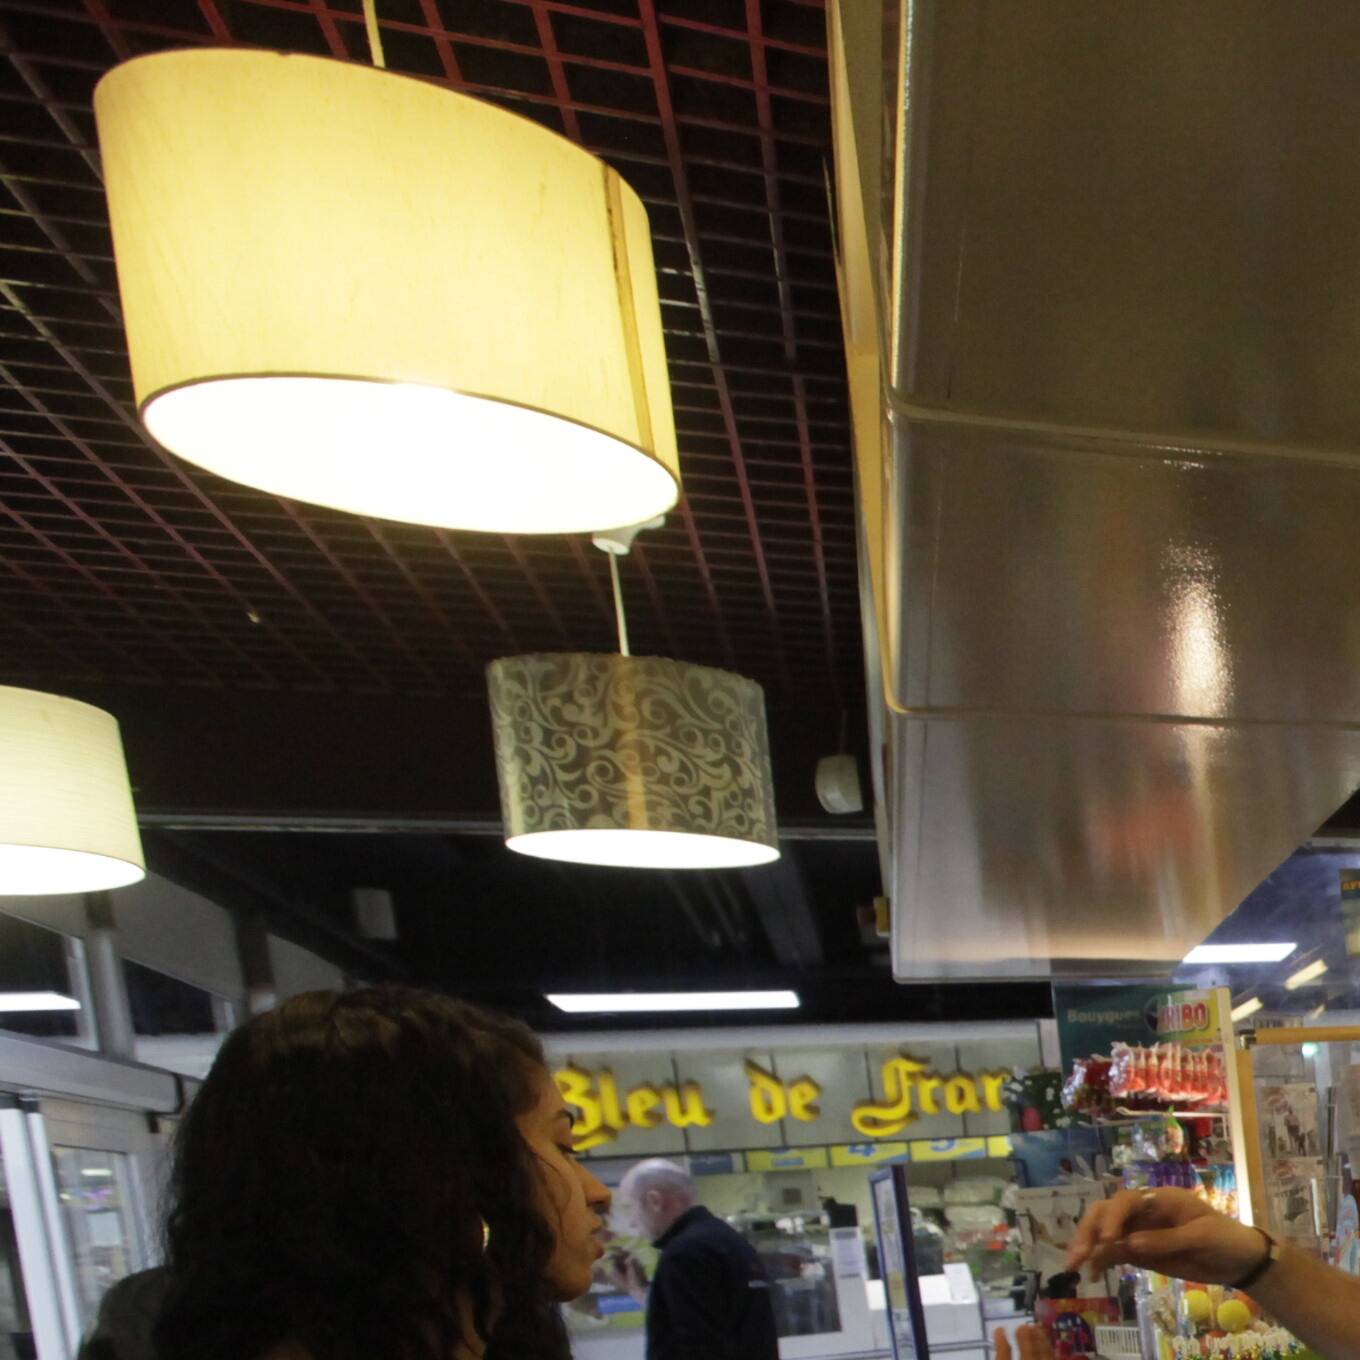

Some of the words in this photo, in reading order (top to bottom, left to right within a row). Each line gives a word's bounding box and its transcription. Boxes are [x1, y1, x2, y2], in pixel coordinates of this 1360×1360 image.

[554, 1062, 716, 1153] Bleu
[744, 1056, 823, 1126] de
[850, 1048, 1014, 1138] Fran
